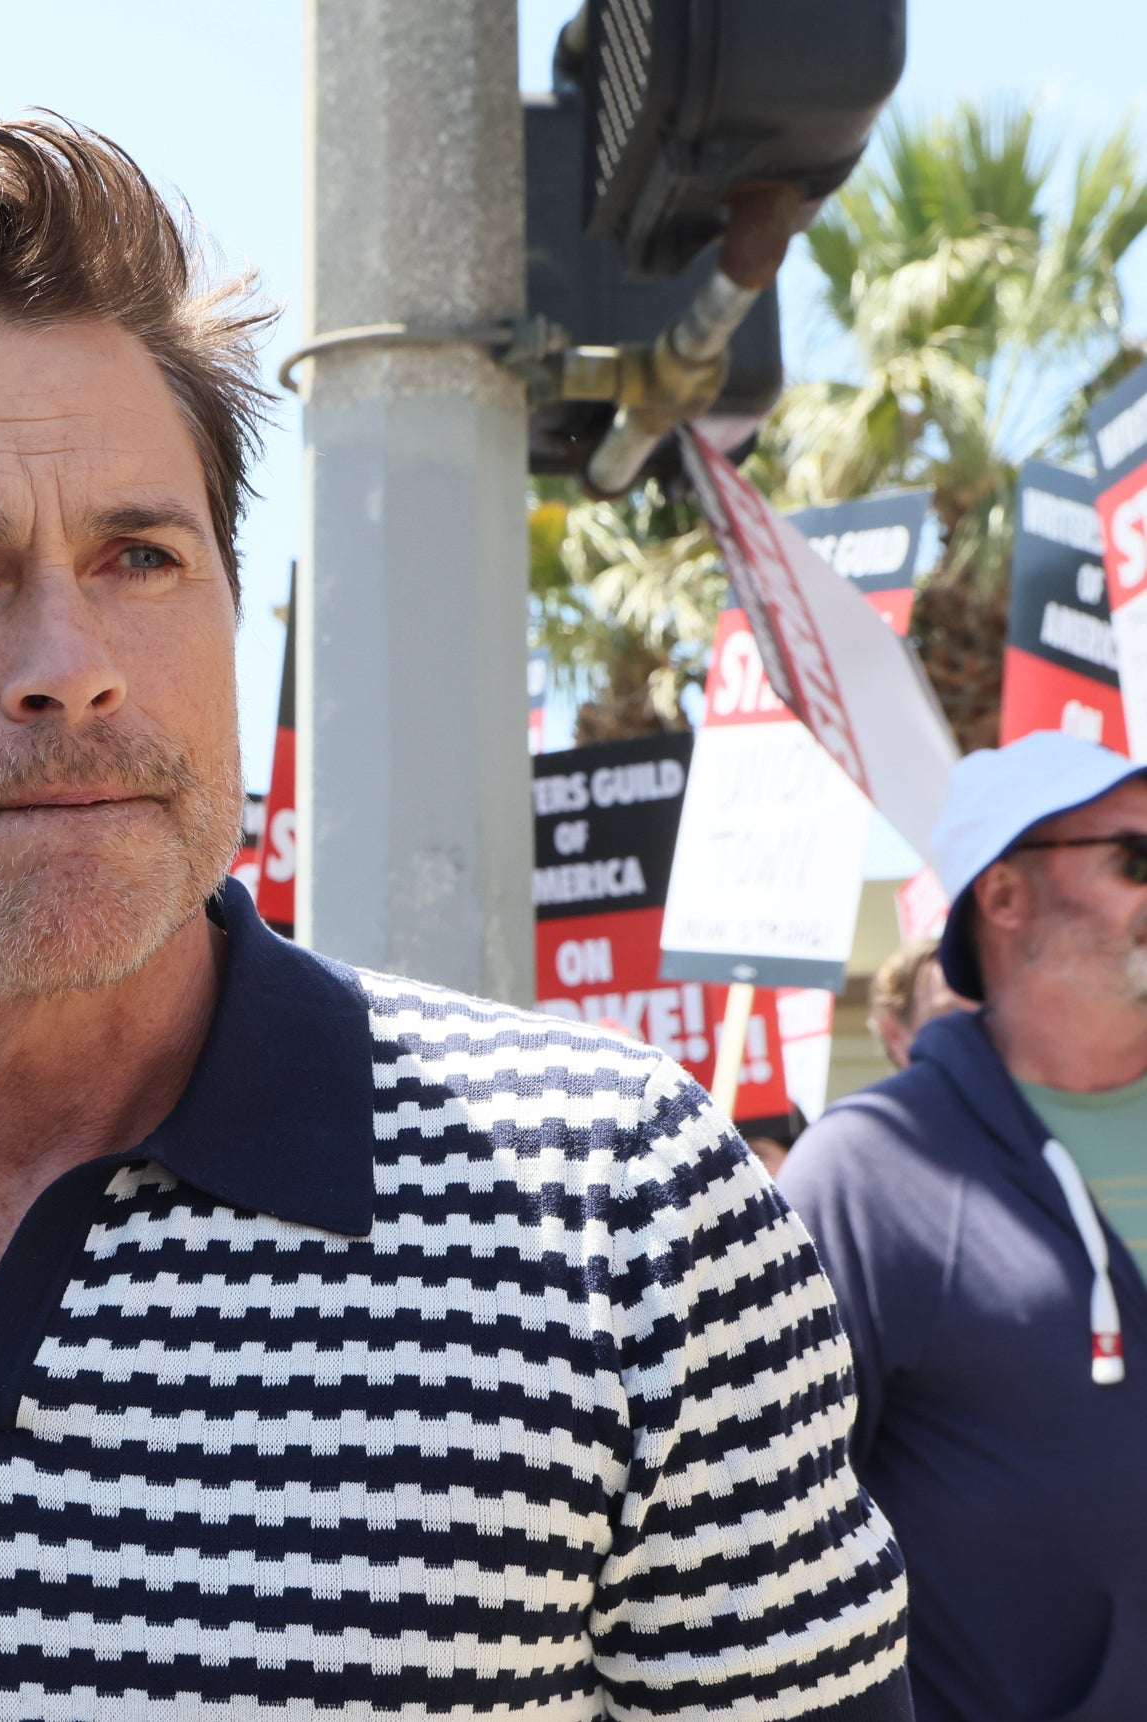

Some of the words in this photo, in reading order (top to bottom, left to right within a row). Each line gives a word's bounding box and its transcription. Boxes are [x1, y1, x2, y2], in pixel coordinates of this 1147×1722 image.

[591, 758, 685, 808] GUILD
[553, 819, 590, 856] OF
[532, 855, 647, 907] MERICA
[555, 936, 614, 988] ON
